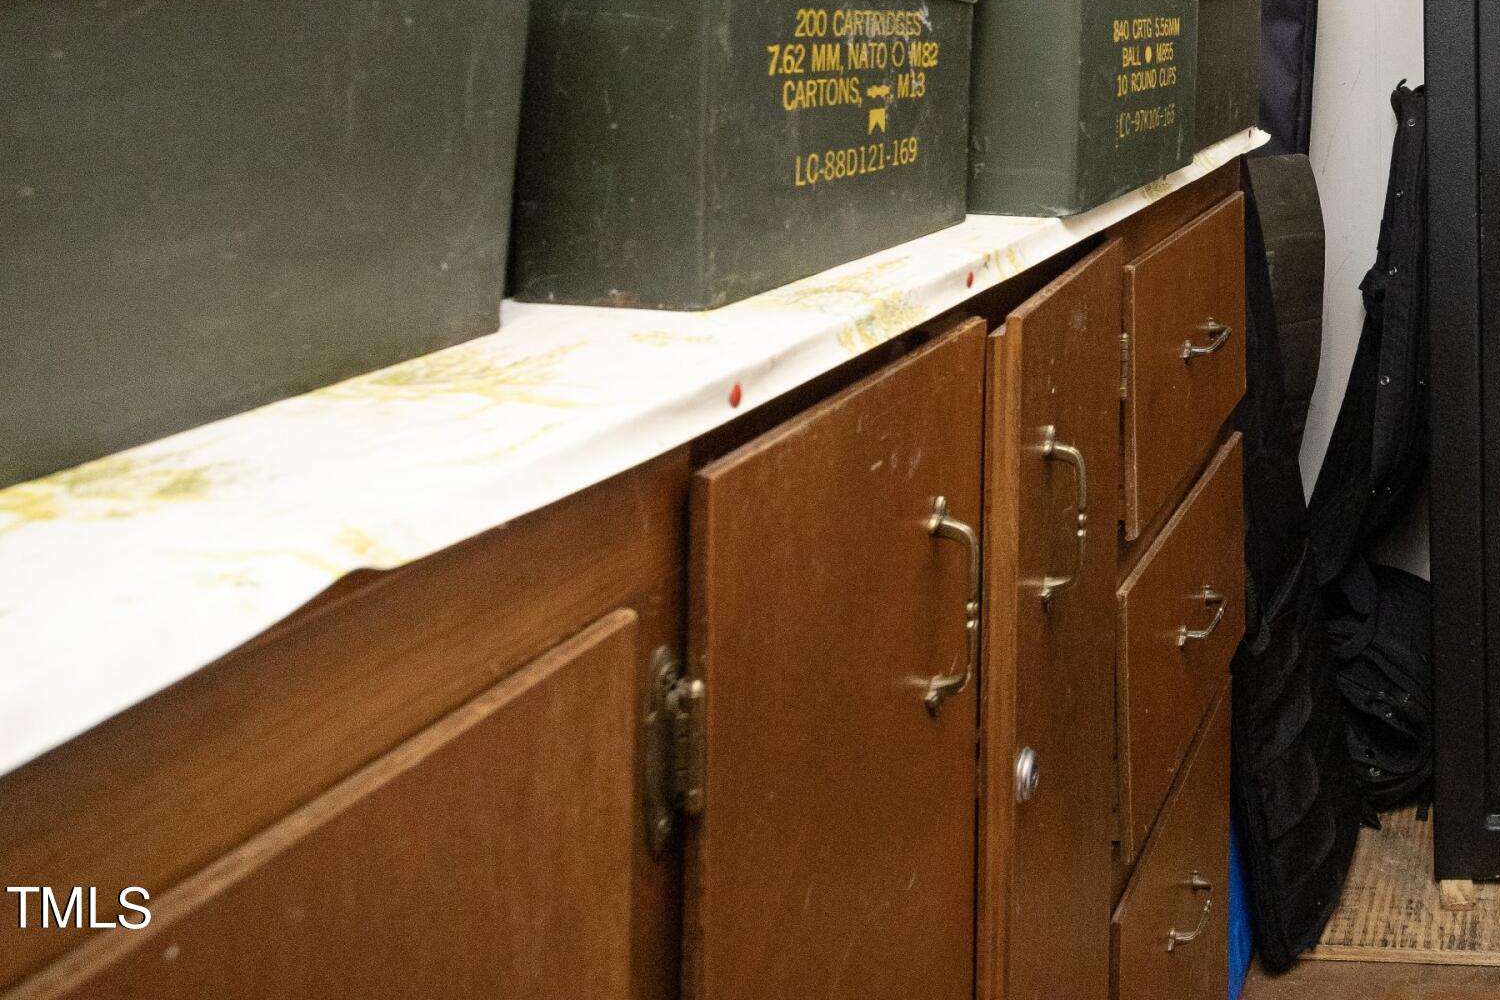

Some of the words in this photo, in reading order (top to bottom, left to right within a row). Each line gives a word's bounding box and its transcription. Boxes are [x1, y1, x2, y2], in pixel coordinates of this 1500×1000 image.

[795, 8, 827, 37] 200
[833, 9, 922, 37] CARTRIDGES
[767, 43, 804, 76] 7.62
[811, 43, 844, 74] MM,
[849, 41, 888, 70] NATO
[1122, 46, 1141, 68] BALL
[783, 76, 862, 111] CARTONS,
[897, 71, 926, 99] M13
[1117, 74, 1128, 97] 10
[1131, 68, 1157, 93] ROUND
[1159, 66, 1177, 86] CLIPS
